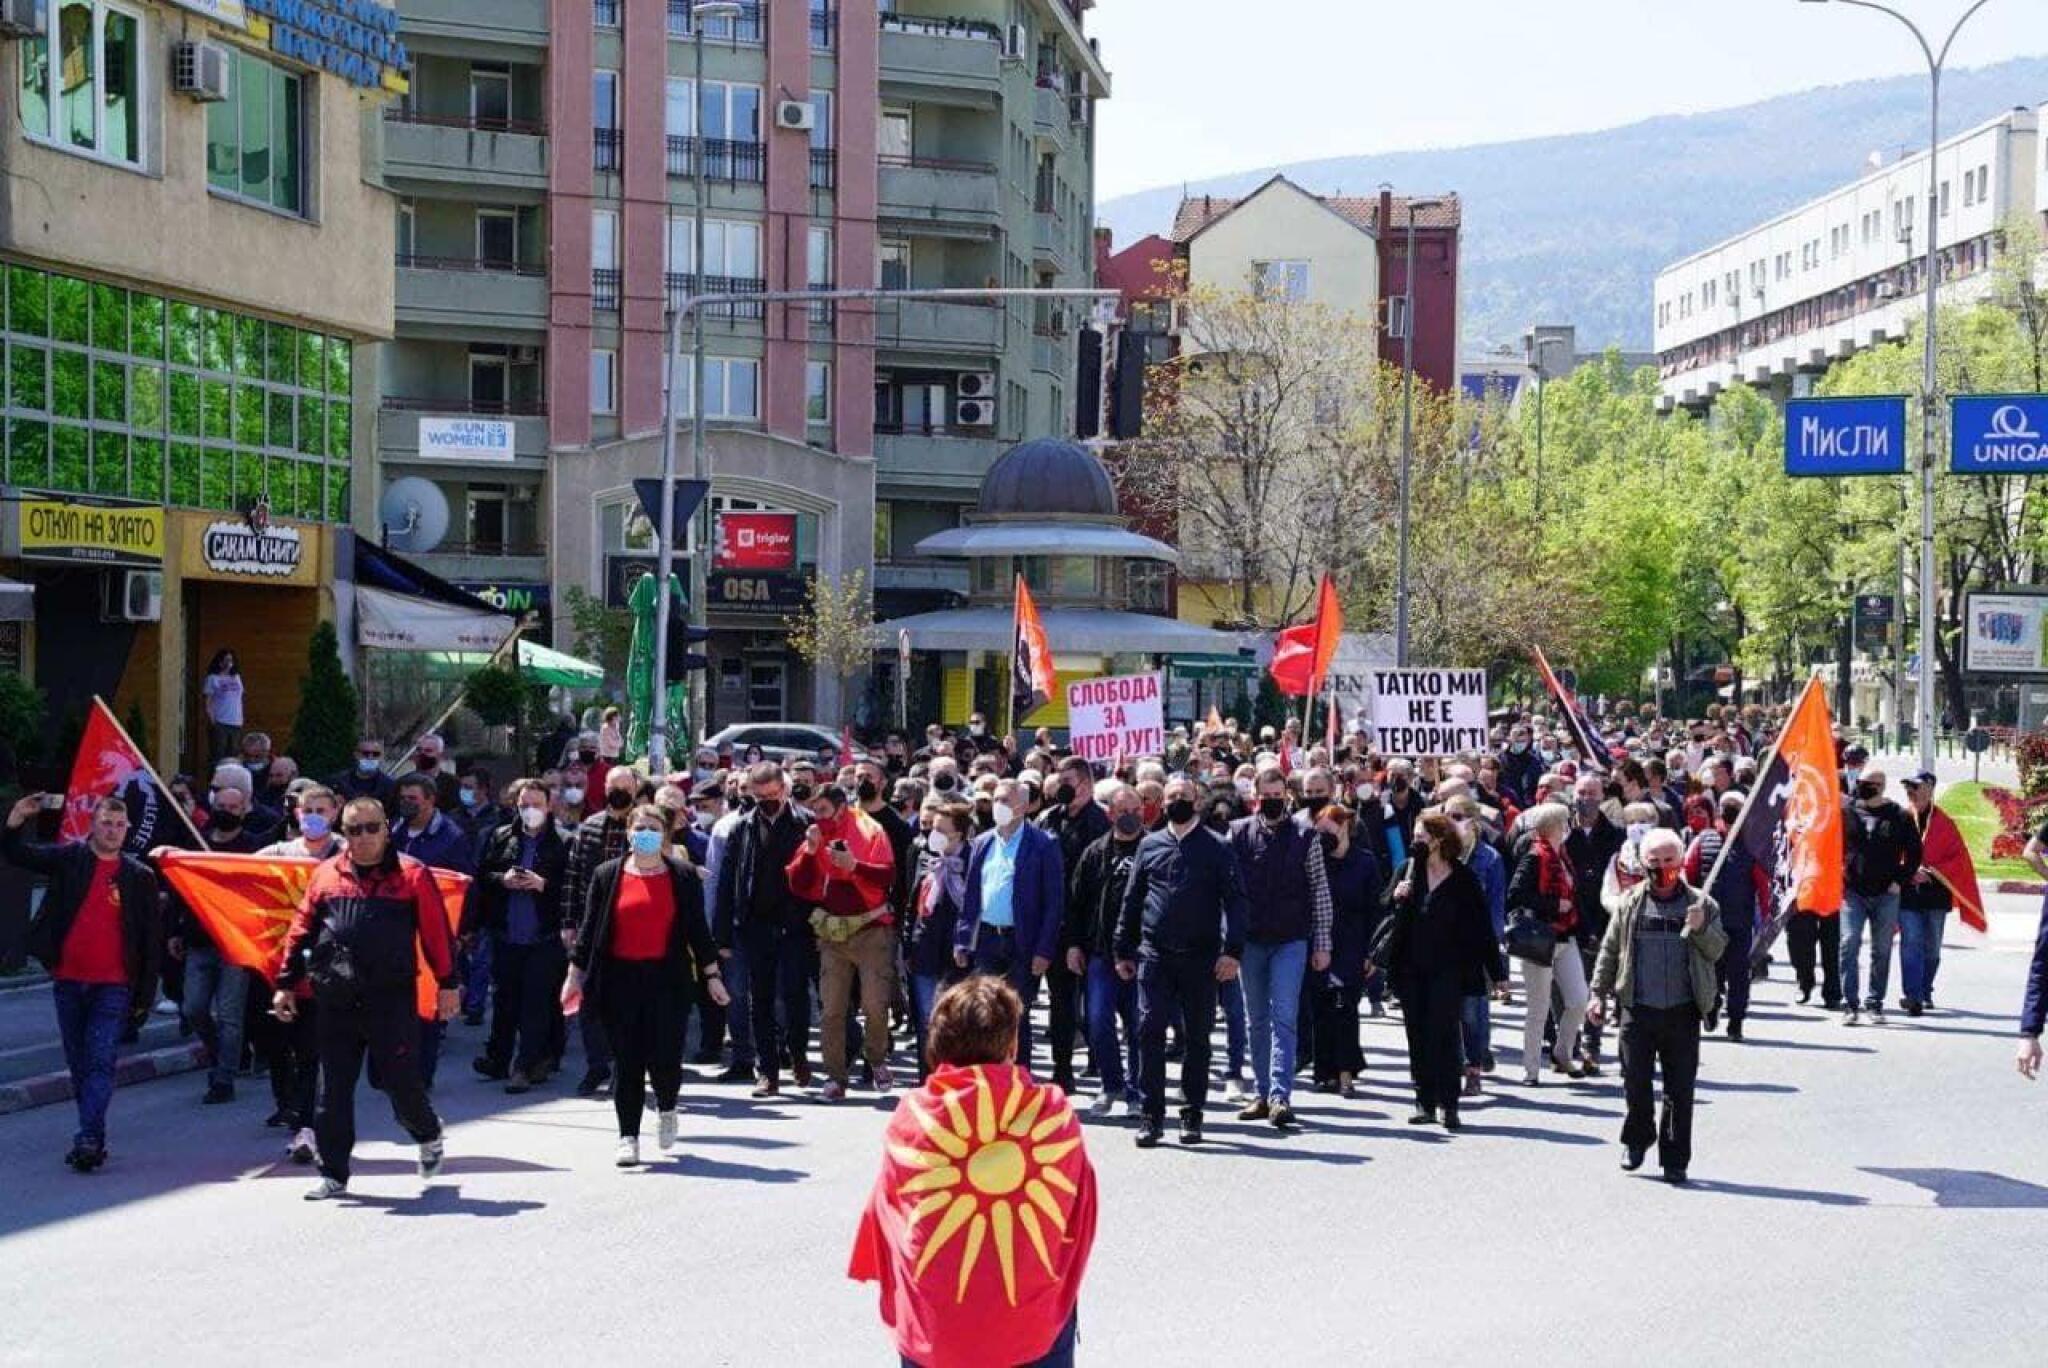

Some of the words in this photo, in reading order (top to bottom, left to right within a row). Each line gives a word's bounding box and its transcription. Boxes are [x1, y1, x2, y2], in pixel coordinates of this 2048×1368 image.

[428, 431, 485, 446] WOMEN
[1801, 415, 1889, 457] Мисли
[29, 508, 80, 543] ОТКУП
[84, 513, 104, 543] НА
[108, 514, 155, 547] ЗЛАТО
[212, 535, 257, 562] САКАМ
[260, 538, 300, 564] КНИГИ
[723, 578, 771, 601] OSA
[1070, 676, 1158, 707] СЛОБОДА
[1374, 672, 1442, 696] ТАТКО
[1447, 673, 1483, 696] МИ
[1103, 705, 1127, 729] ЗА
[1408, 700, 1436, 723] НЕ
[1441, 700, 1453, 723] Е
[1073, 732, 1119, 759] ИГОР
[1377, 727, 1487, 754] ТЕРОРИСТ!
